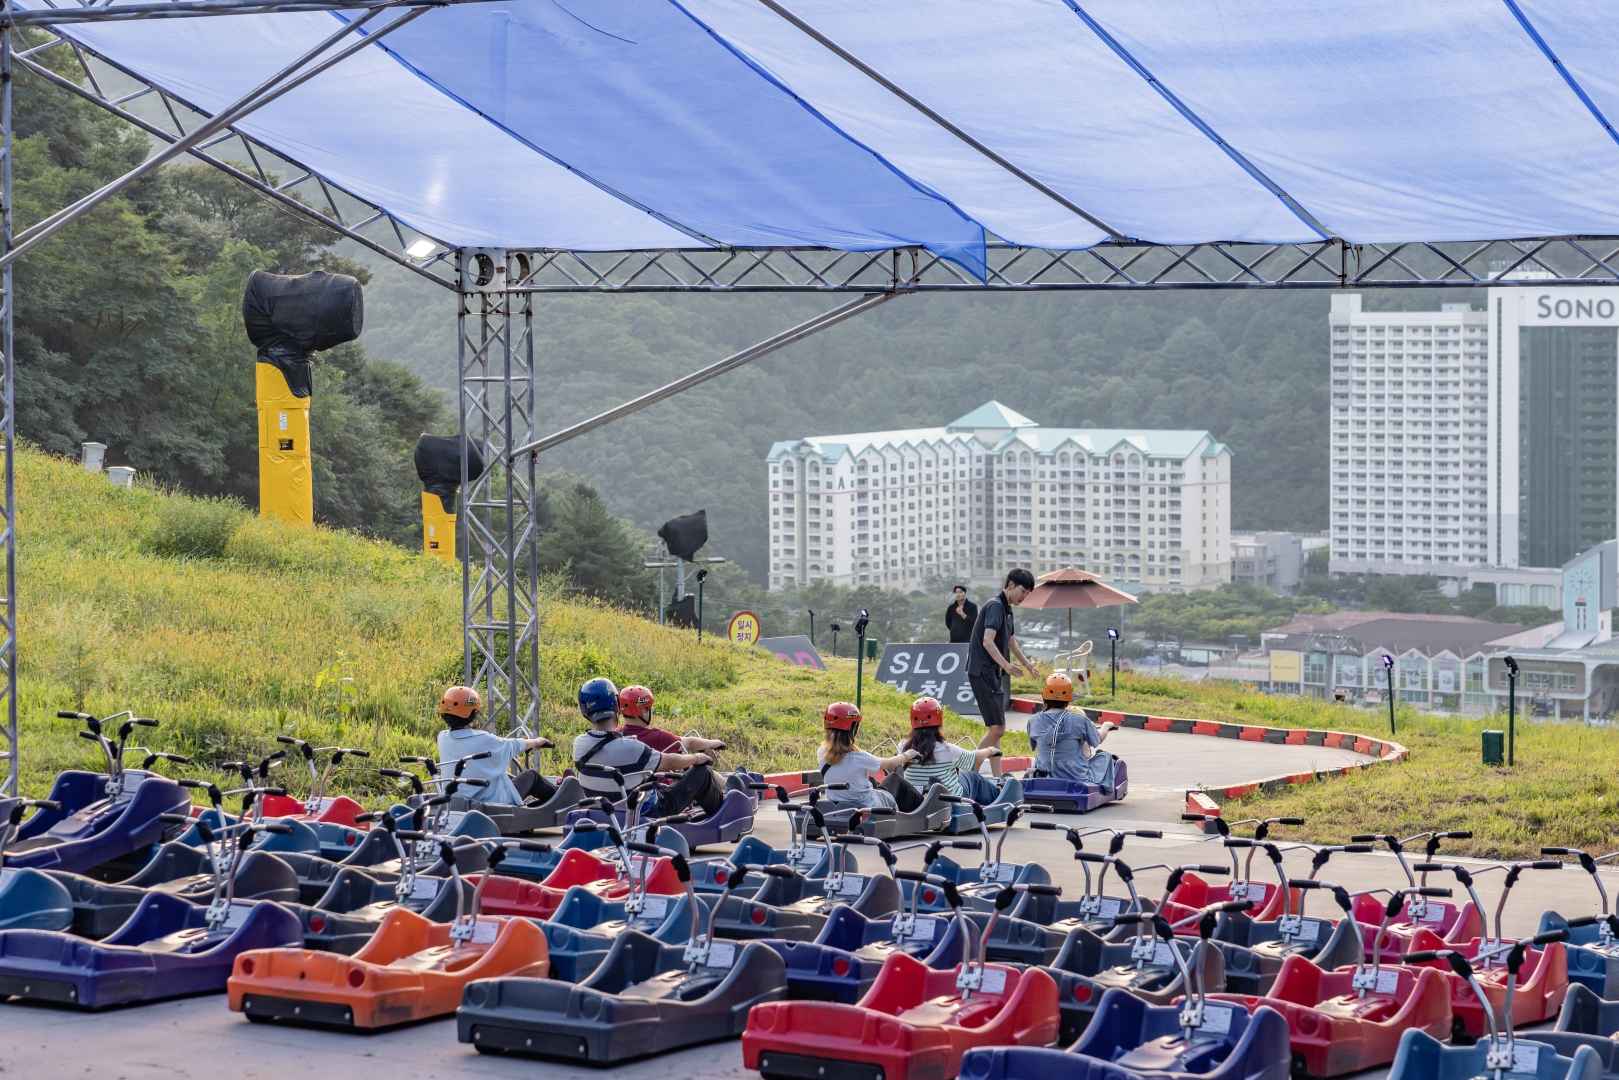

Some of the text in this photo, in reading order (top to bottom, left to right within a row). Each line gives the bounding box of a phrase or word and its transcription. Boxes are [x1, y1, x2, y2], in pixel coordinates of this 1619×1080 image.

[1537, 295, 1615, 319] SONO
[737, 620, 752, 630] 일시
[736, 632, 752, 641] 정지
[889, 652, 969, 674] SLO
